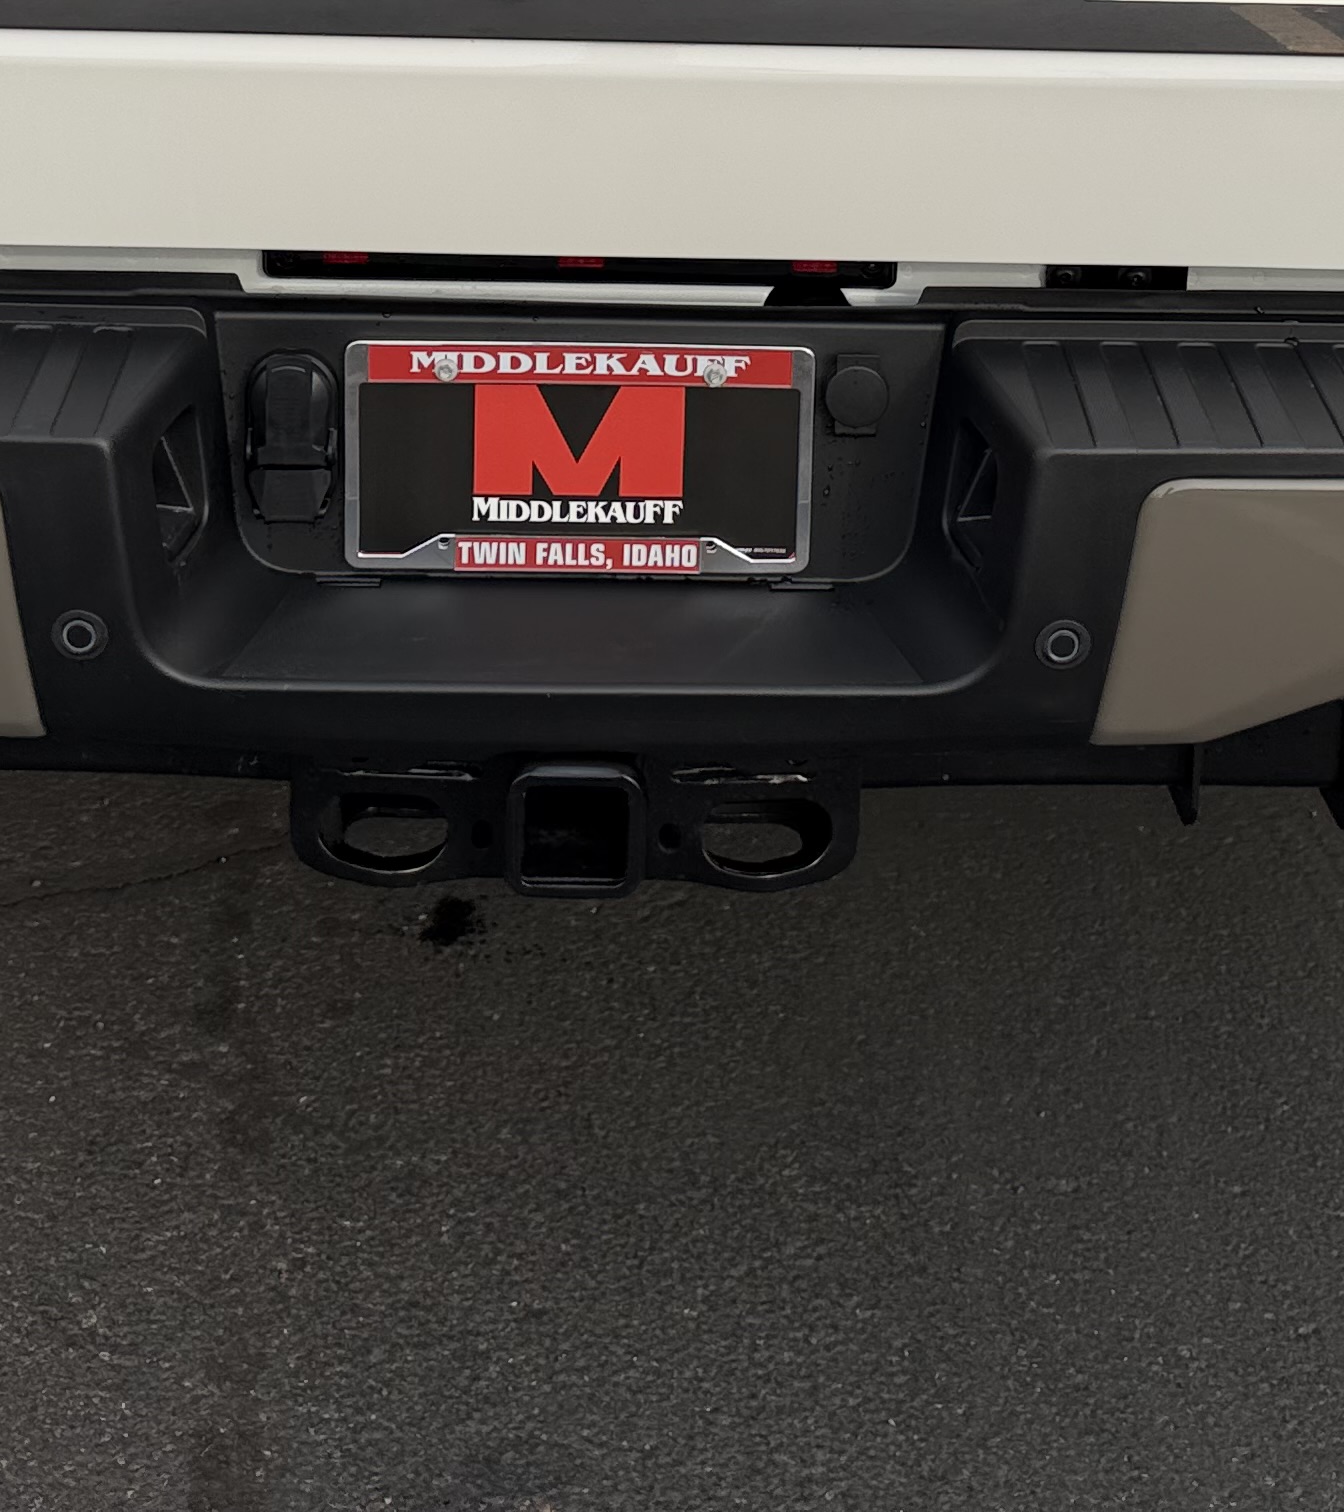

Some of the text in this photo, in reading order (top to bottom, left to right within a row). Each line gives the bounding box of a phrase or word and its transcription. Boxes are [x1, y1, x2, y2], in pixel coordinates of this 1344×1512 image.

[472, 384, 686, 497] M
[457, 541, 698, 570] TWIN FALLS, IDAHO
